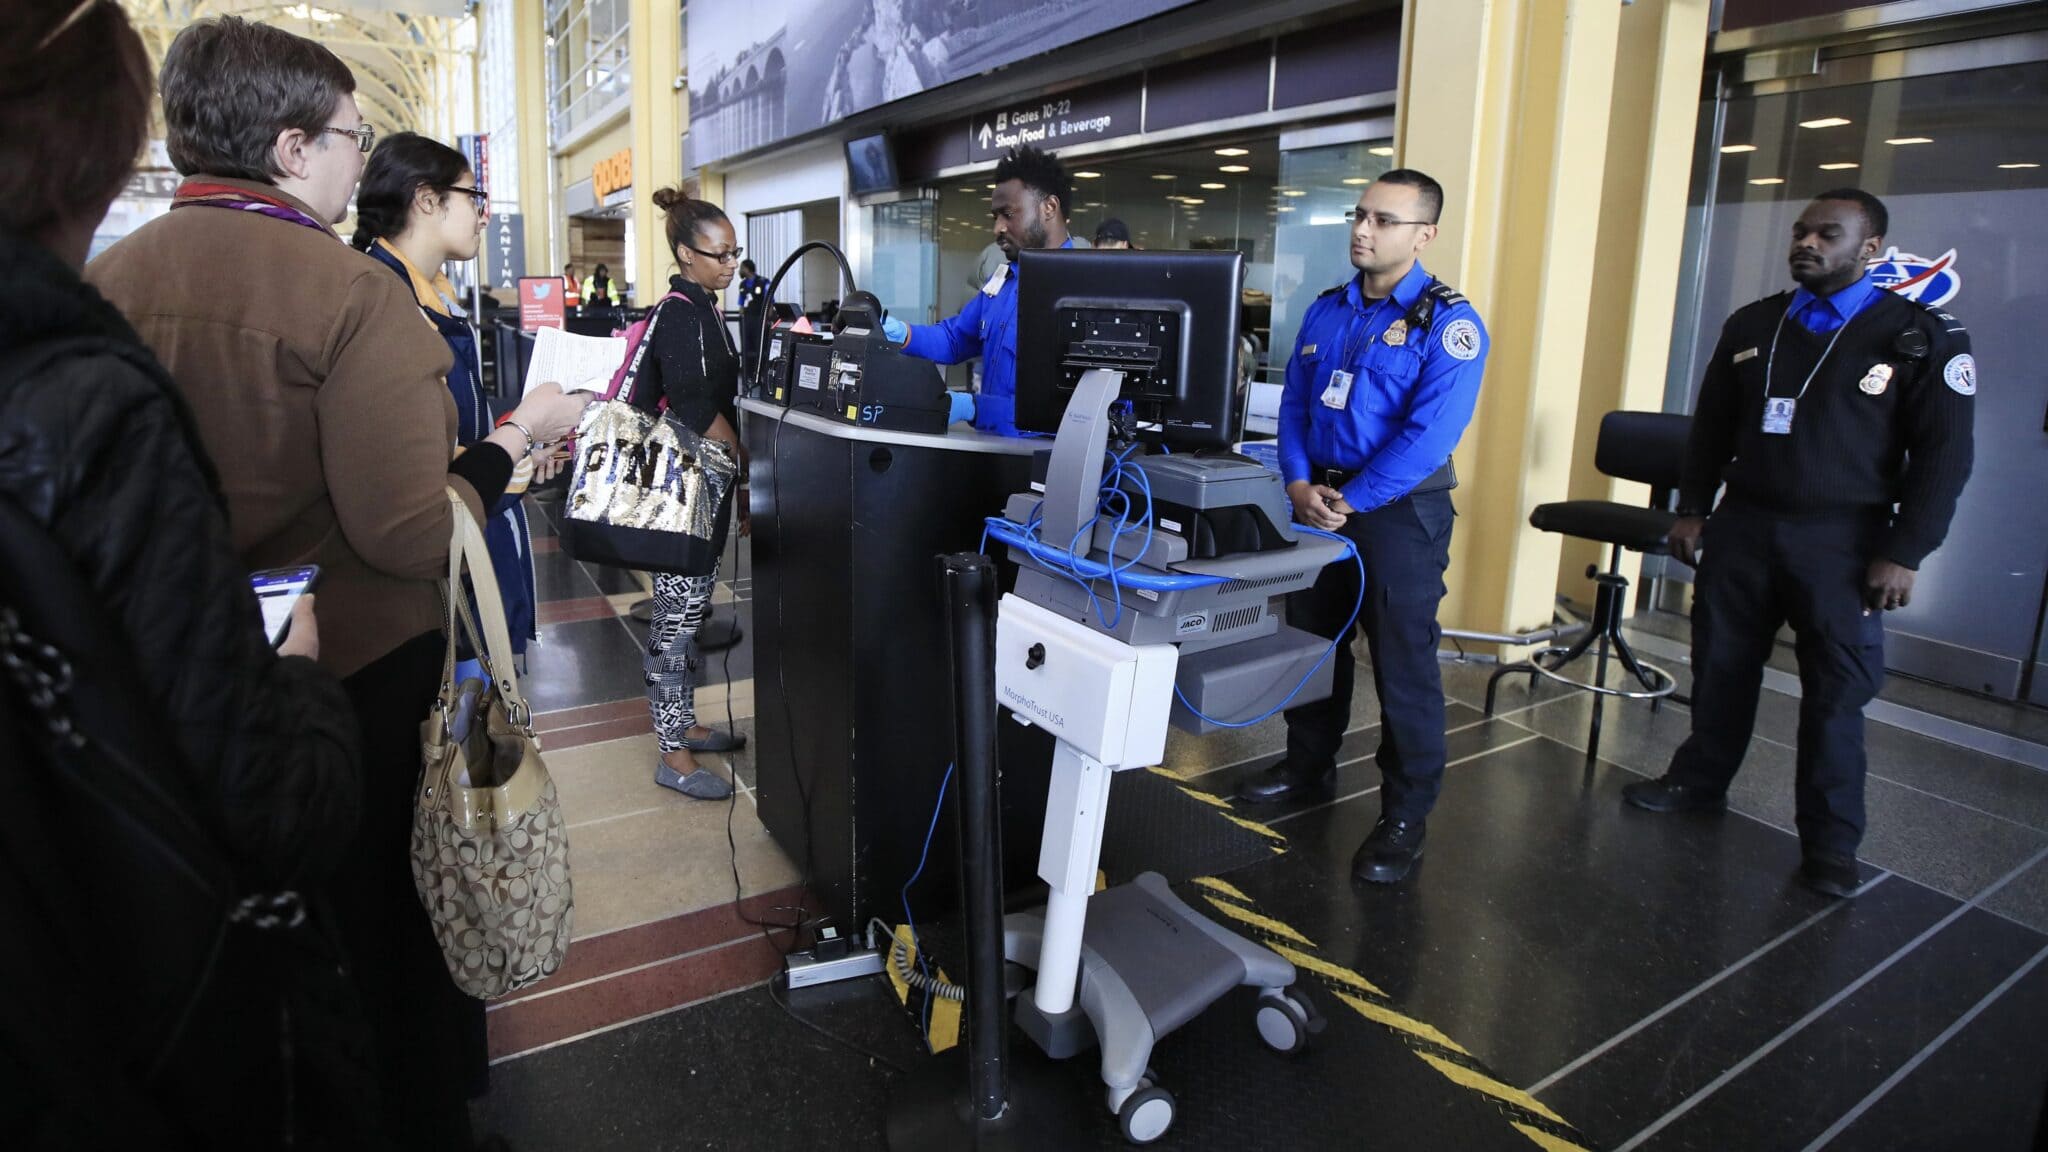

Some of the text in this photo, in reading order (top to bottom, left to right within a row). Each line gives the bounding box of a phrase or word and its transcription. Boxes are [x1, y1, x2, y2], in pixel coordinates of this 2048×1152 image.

[1012, 99, 1071, 126] Gates 10-22
[995, 115, 1111, 148] Shop/Food & Beverage
[499, 214, 513, 288] CANTINA
[863, 405, 884, 423] SP
[576, 438, 701, 506] PINK
[1180, 619, 1202, 629] JACO
[1004, 685, 1064, 728] MorphoTrust USA
